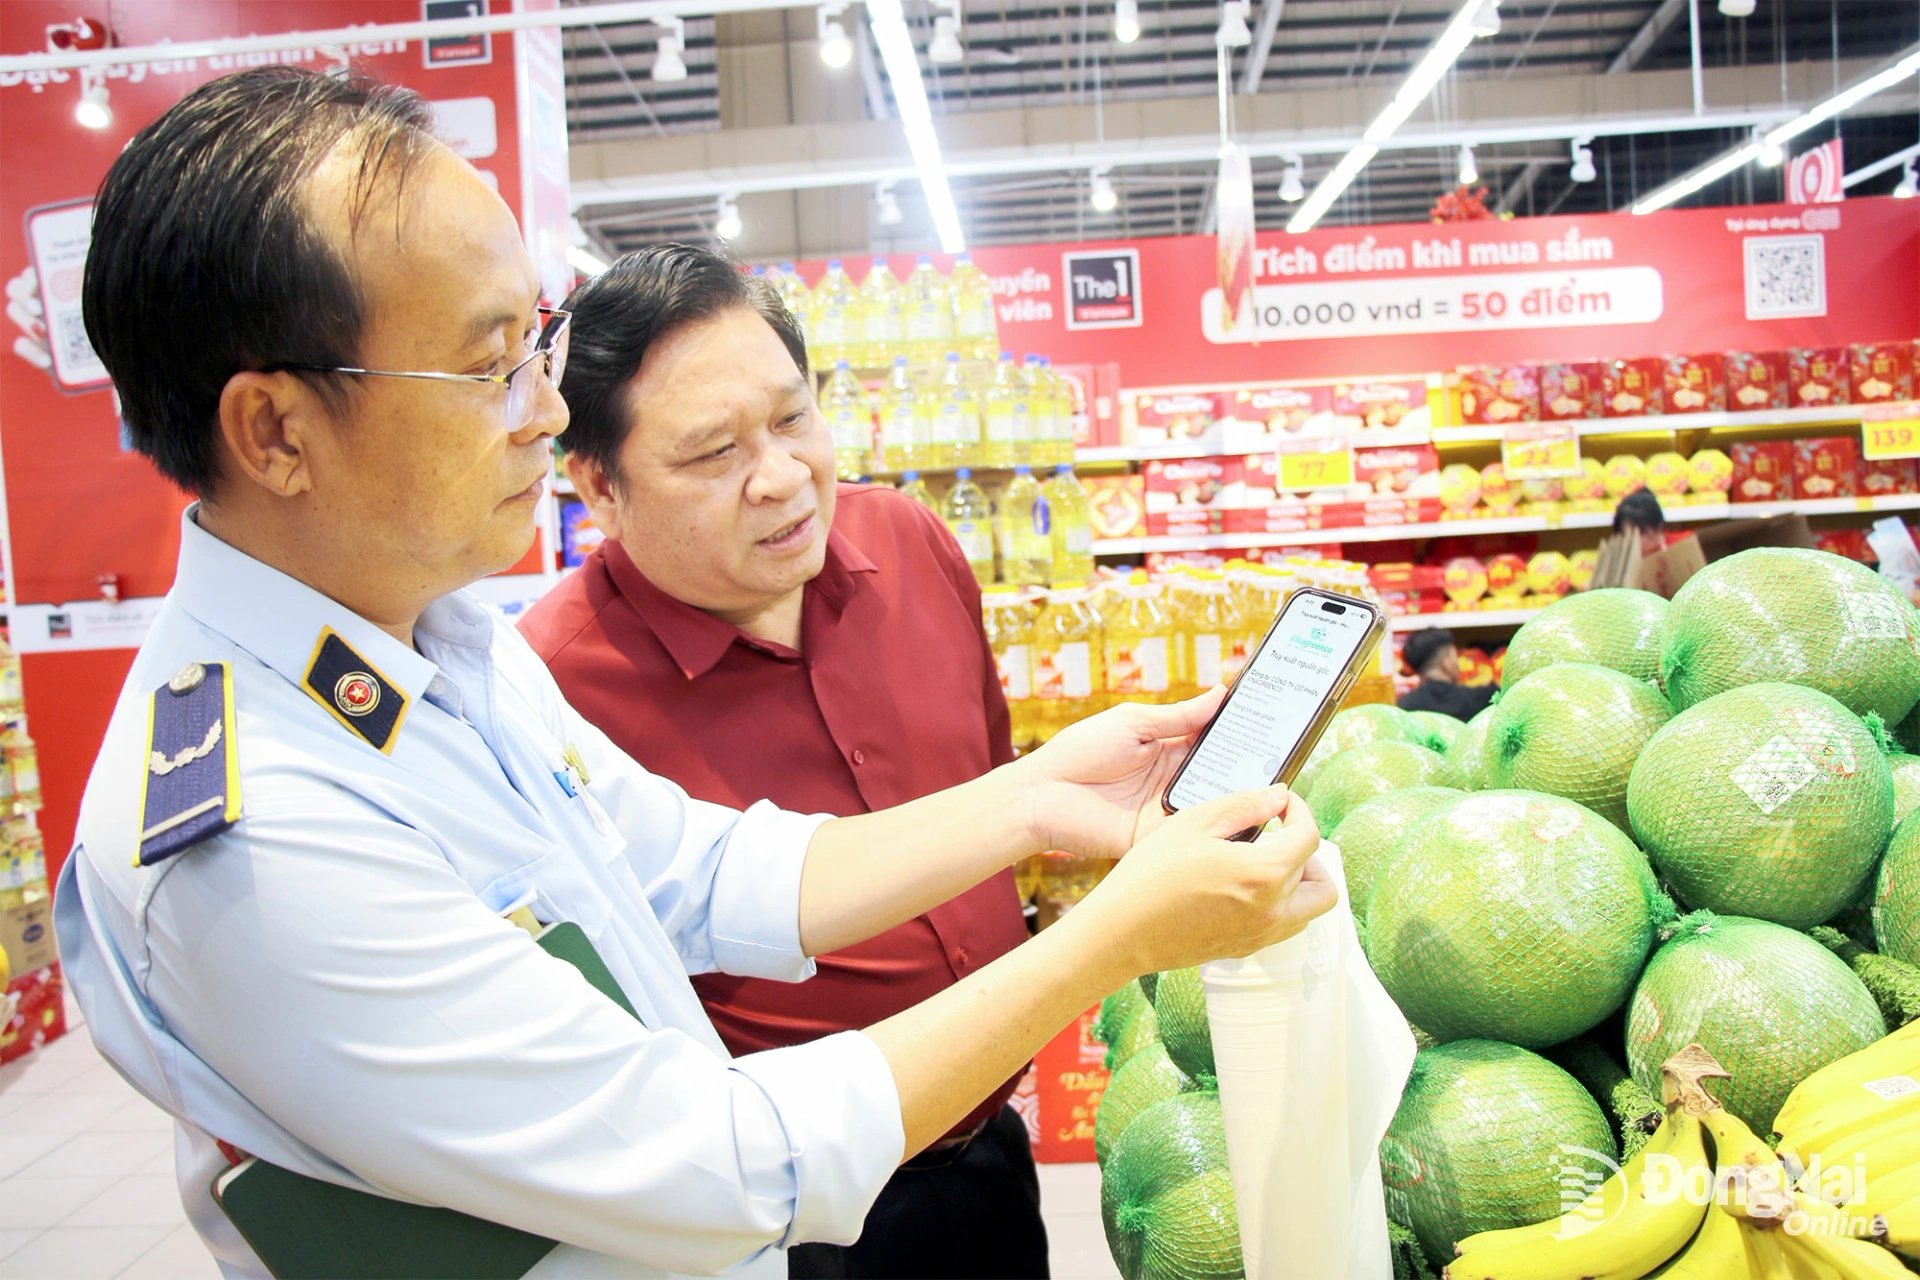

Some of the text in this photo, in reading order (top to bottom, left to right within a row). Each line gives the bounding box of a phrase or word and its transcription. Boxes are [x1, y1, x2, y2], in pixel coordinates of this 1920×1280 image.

[1323, 235, 1405, 274] điểm
[1411, 238, 1462, 268] khi
[1468, 240, 1540, 267] mua
[1545, 225, 1614, 263] sắm
[1367, 298, 1422, 321] vnd
[1461, 291, 1508, 319] 50
[1519, 276, 1612, 316] điểm
[1873, 428, 1913, 447] 139
[1298, 461, 1326, 480] 77
